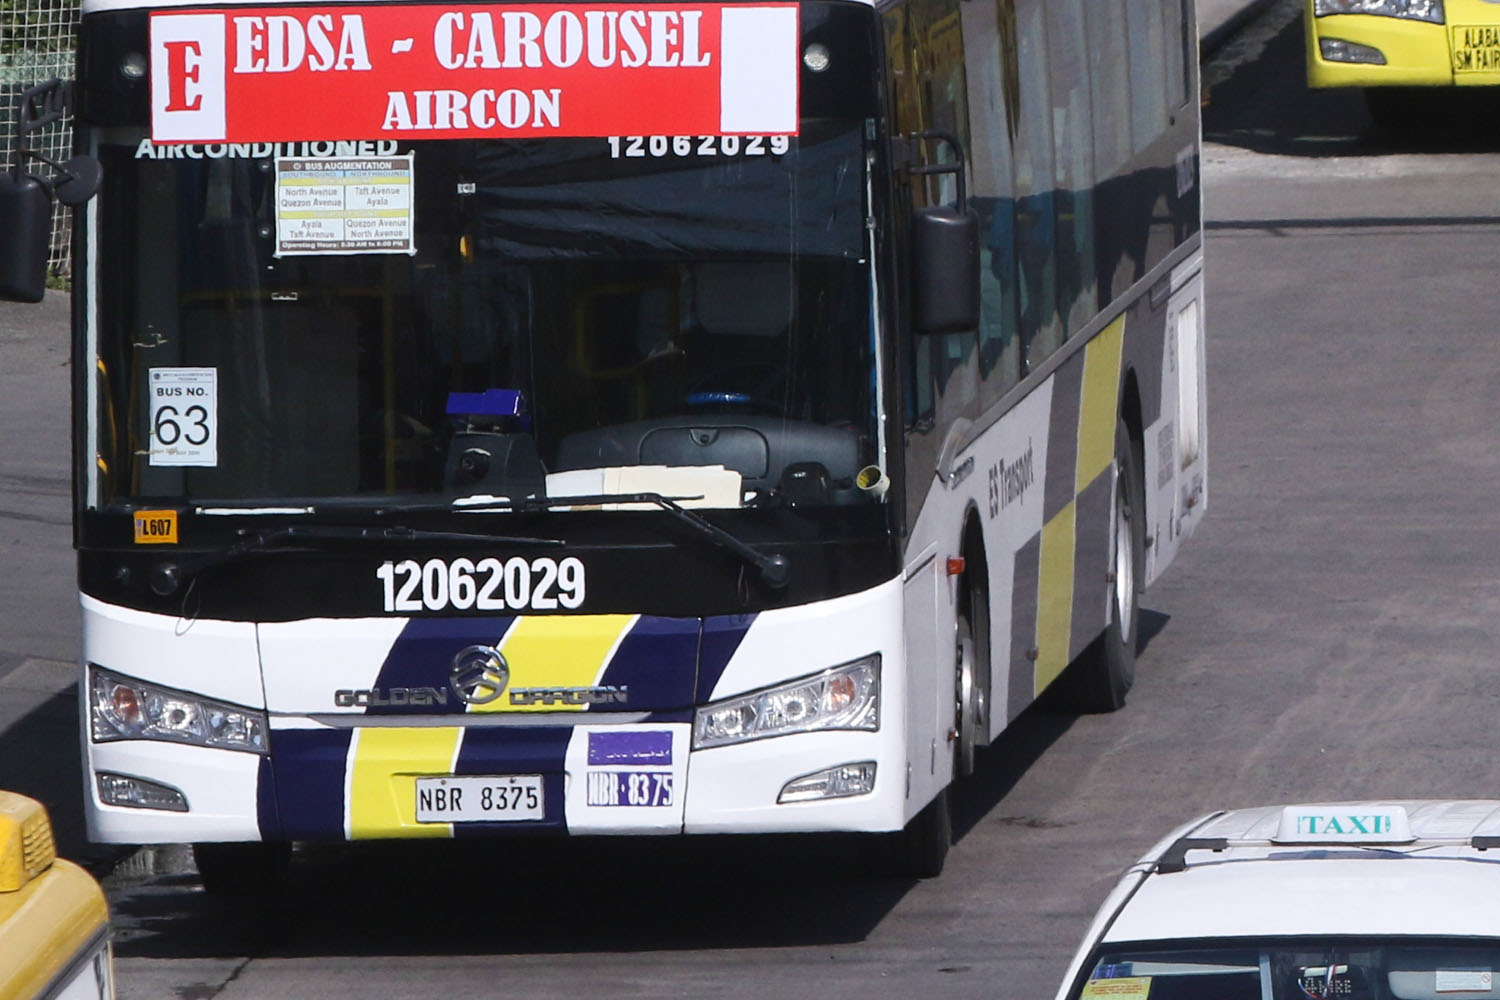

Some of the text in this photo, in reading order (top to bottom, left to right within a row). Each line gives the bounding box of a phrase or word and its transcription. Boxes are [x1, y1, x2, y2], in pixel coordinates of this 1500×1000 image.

[232, 13, 373, 74] EDSA
[433, 10, 712, 70] CAROUSEL
[1455, 50, 1473, 71] SM
[164, 41, 203, 112] E
[381, 88, 562, 130] AIRCON
[134, 138, 399, 160] AIRCONDITIONED
[607, 135, 790, 158] 12062029
[304, 161, 393, 171] BUS AUGMENTATION
[285, 187, 338, 197] North Avenue
[355, 186, 400, 195] Taft Avenue
[281, 198, 342, 208] Quezon Avenue
[366, 197, 389, 207] Ayala
[301, 220, 323, 230] Ayala
[346, 218, 407, 229] Quezon Avenue
[306, 231, 335, 239] Avenue
[351, 229, 404, 238] North Avenue
[156, 387, 209, 397] BUS NO.
[154, 404, 210, 446] 63
[143, 519, 171, 536] L607
[376, 556, 586, 612] 12062029
[333, 685, 629, 707] GOLDEN DRAGON
[420, 785, 539, 812] NBR 8375
[1301, 815, 1386, 835] TAXI
